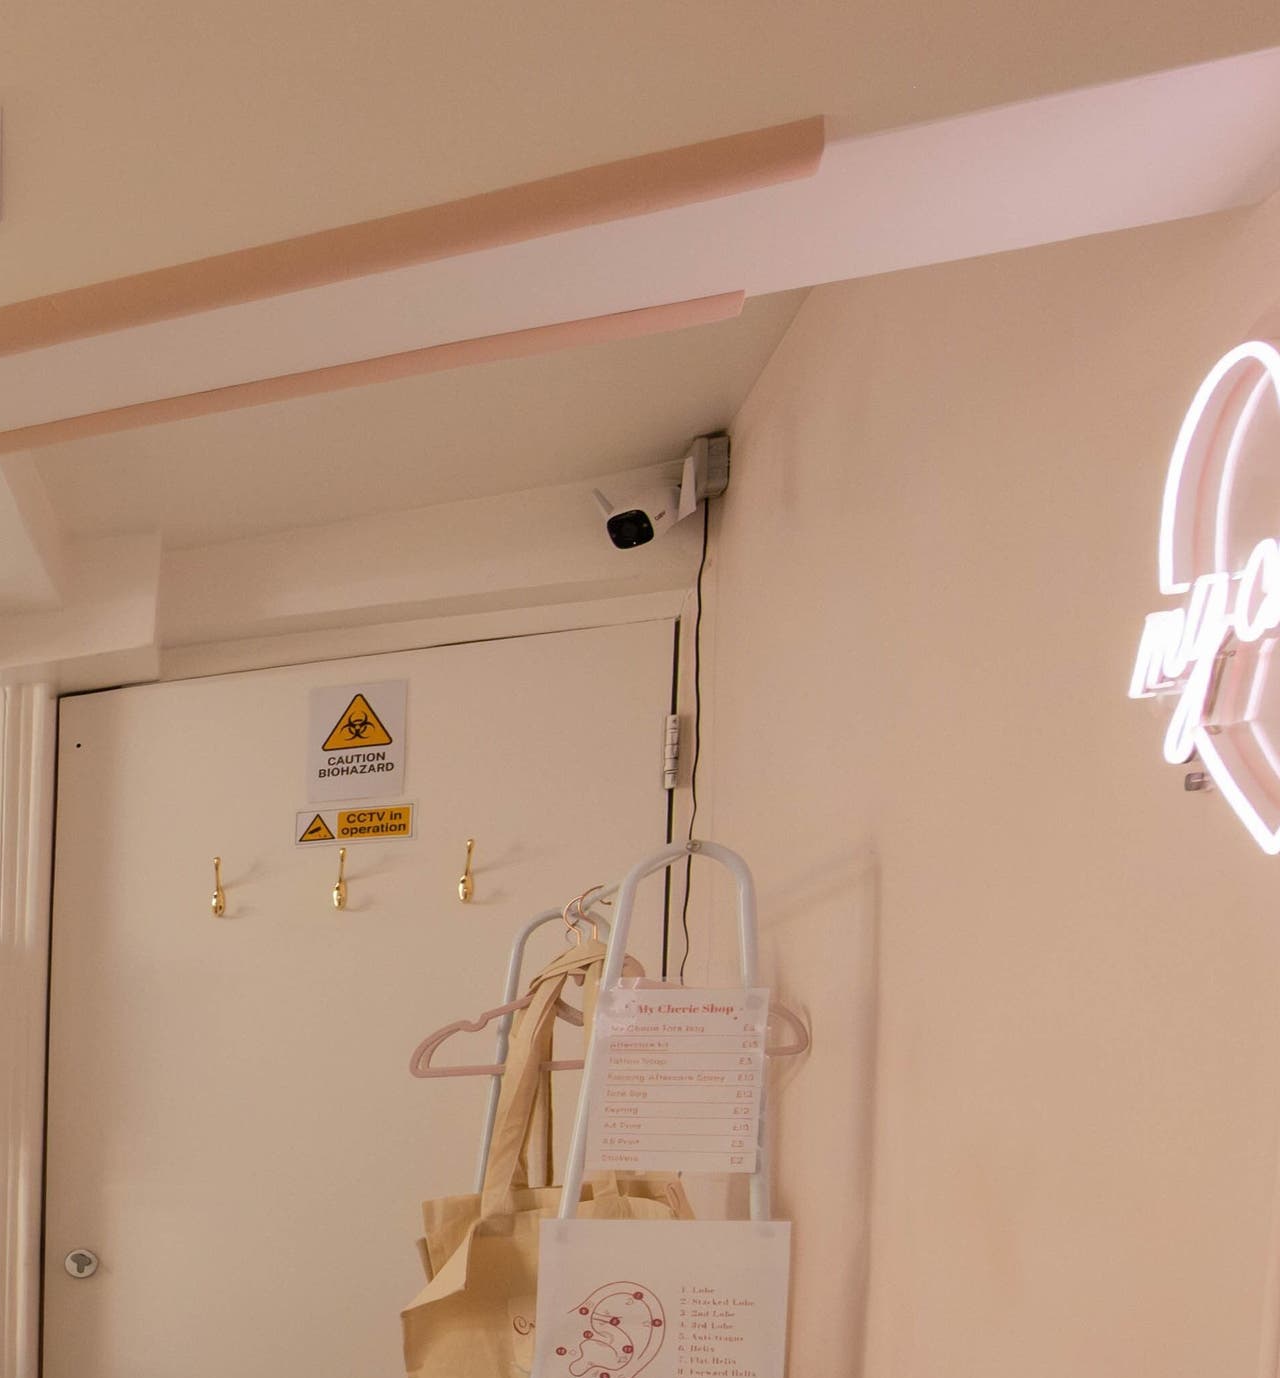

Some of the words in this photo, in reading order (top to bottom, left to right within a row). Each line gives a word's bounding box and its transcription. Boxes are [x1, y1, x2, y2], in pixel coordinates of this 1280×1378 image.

[327, 751, 386, 766] CAUTION
[318, 762, 395, 778] BIOHAZARD
[346, 811, 386, 824] CCTV
[390, 810, 402, 821] in
[341, 821, 407, 837] operation
[702, 1003, 734, 1016] Shop
